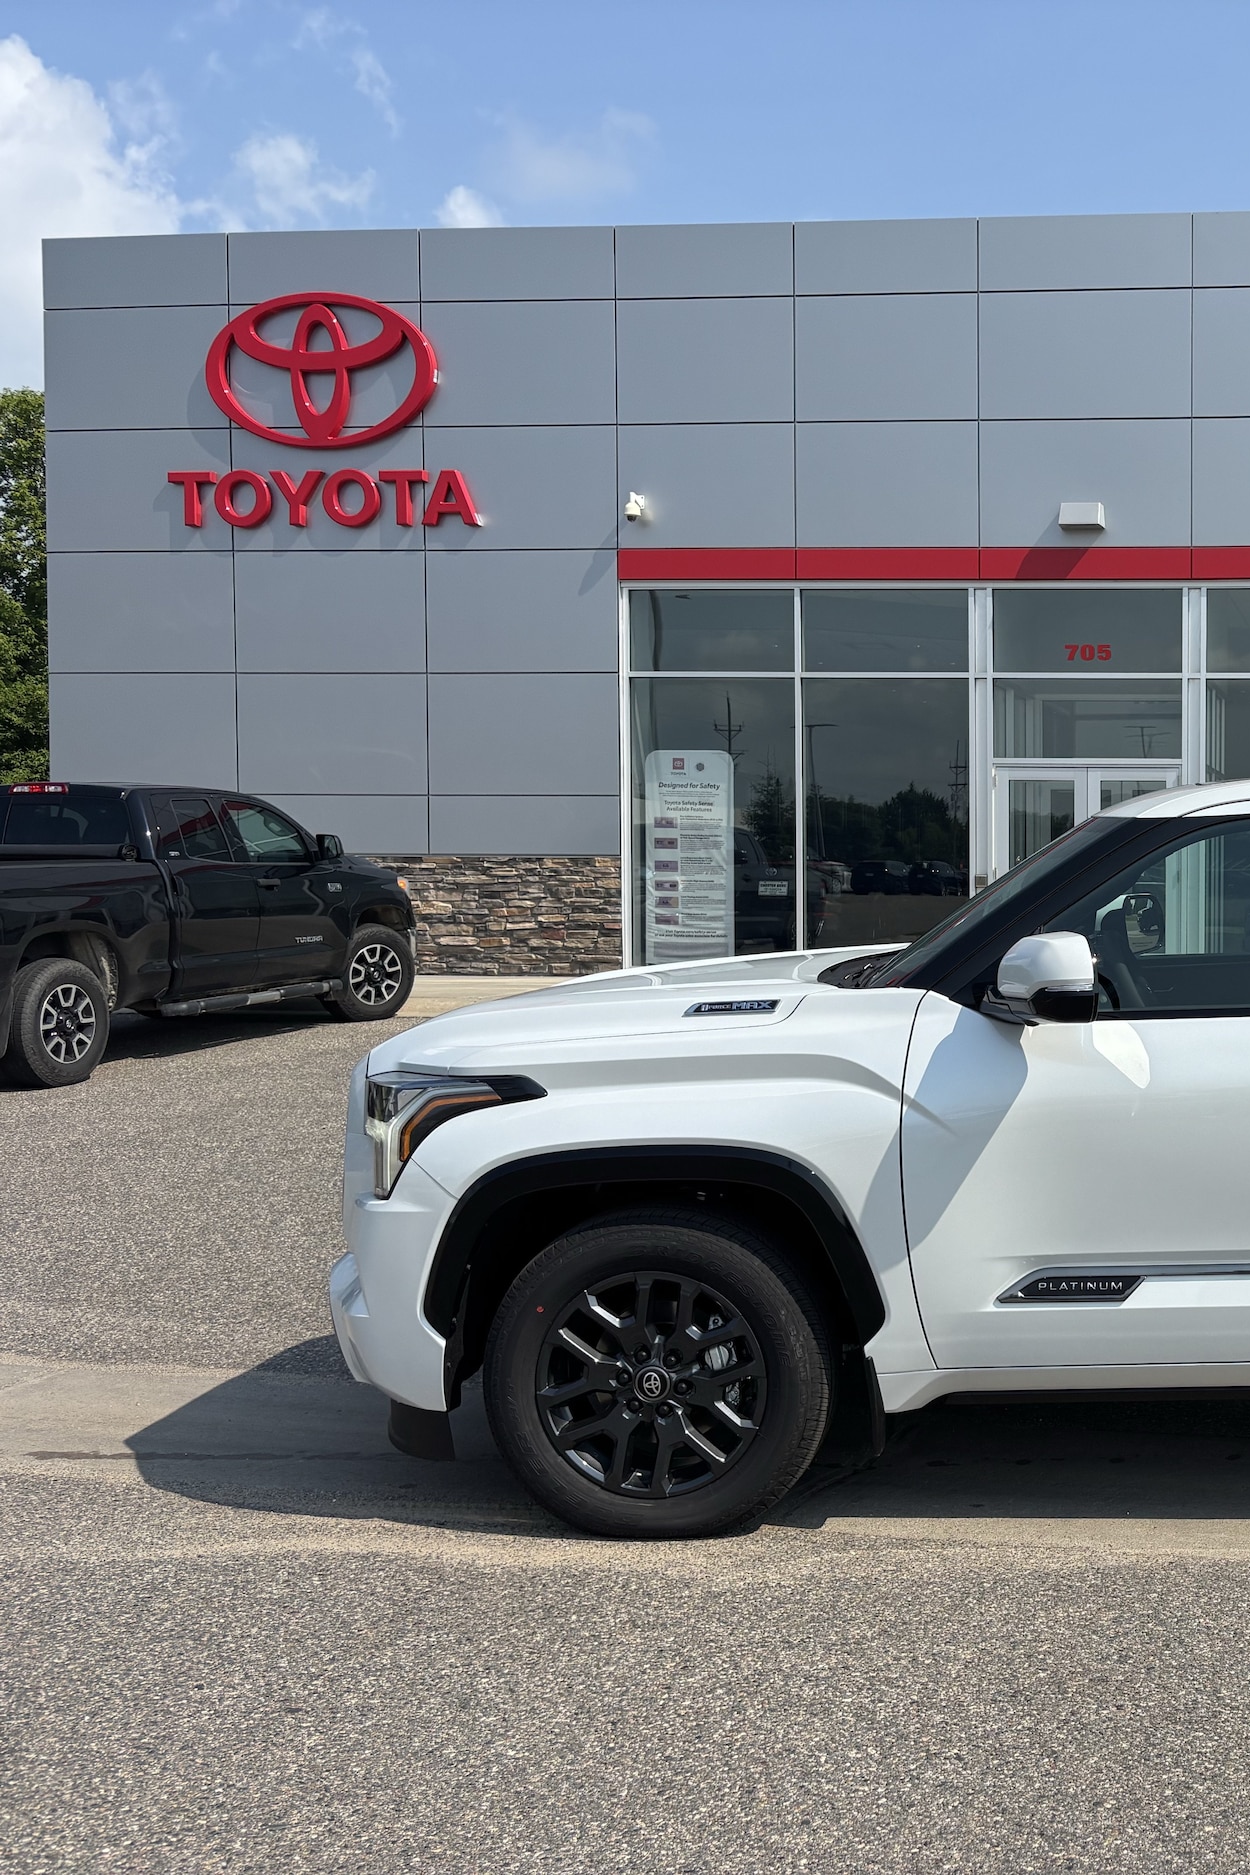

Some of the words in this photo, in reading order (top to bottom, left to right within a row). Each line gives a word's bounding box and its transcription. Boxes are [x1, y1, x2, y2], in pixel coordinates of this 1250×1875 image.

[167, 469, 484, 528] TOYOTA
[1064, 644, 1112, 661] 705
[658, 781, 689, 790] Designed
[699, 782, 721, 791] Safety
[732, 1001, 772, 1010] MAX
[1038, 1281, 1123, 1291] PLATINUM
[630, 1245, 794, 1367] BRIDGESTONE
